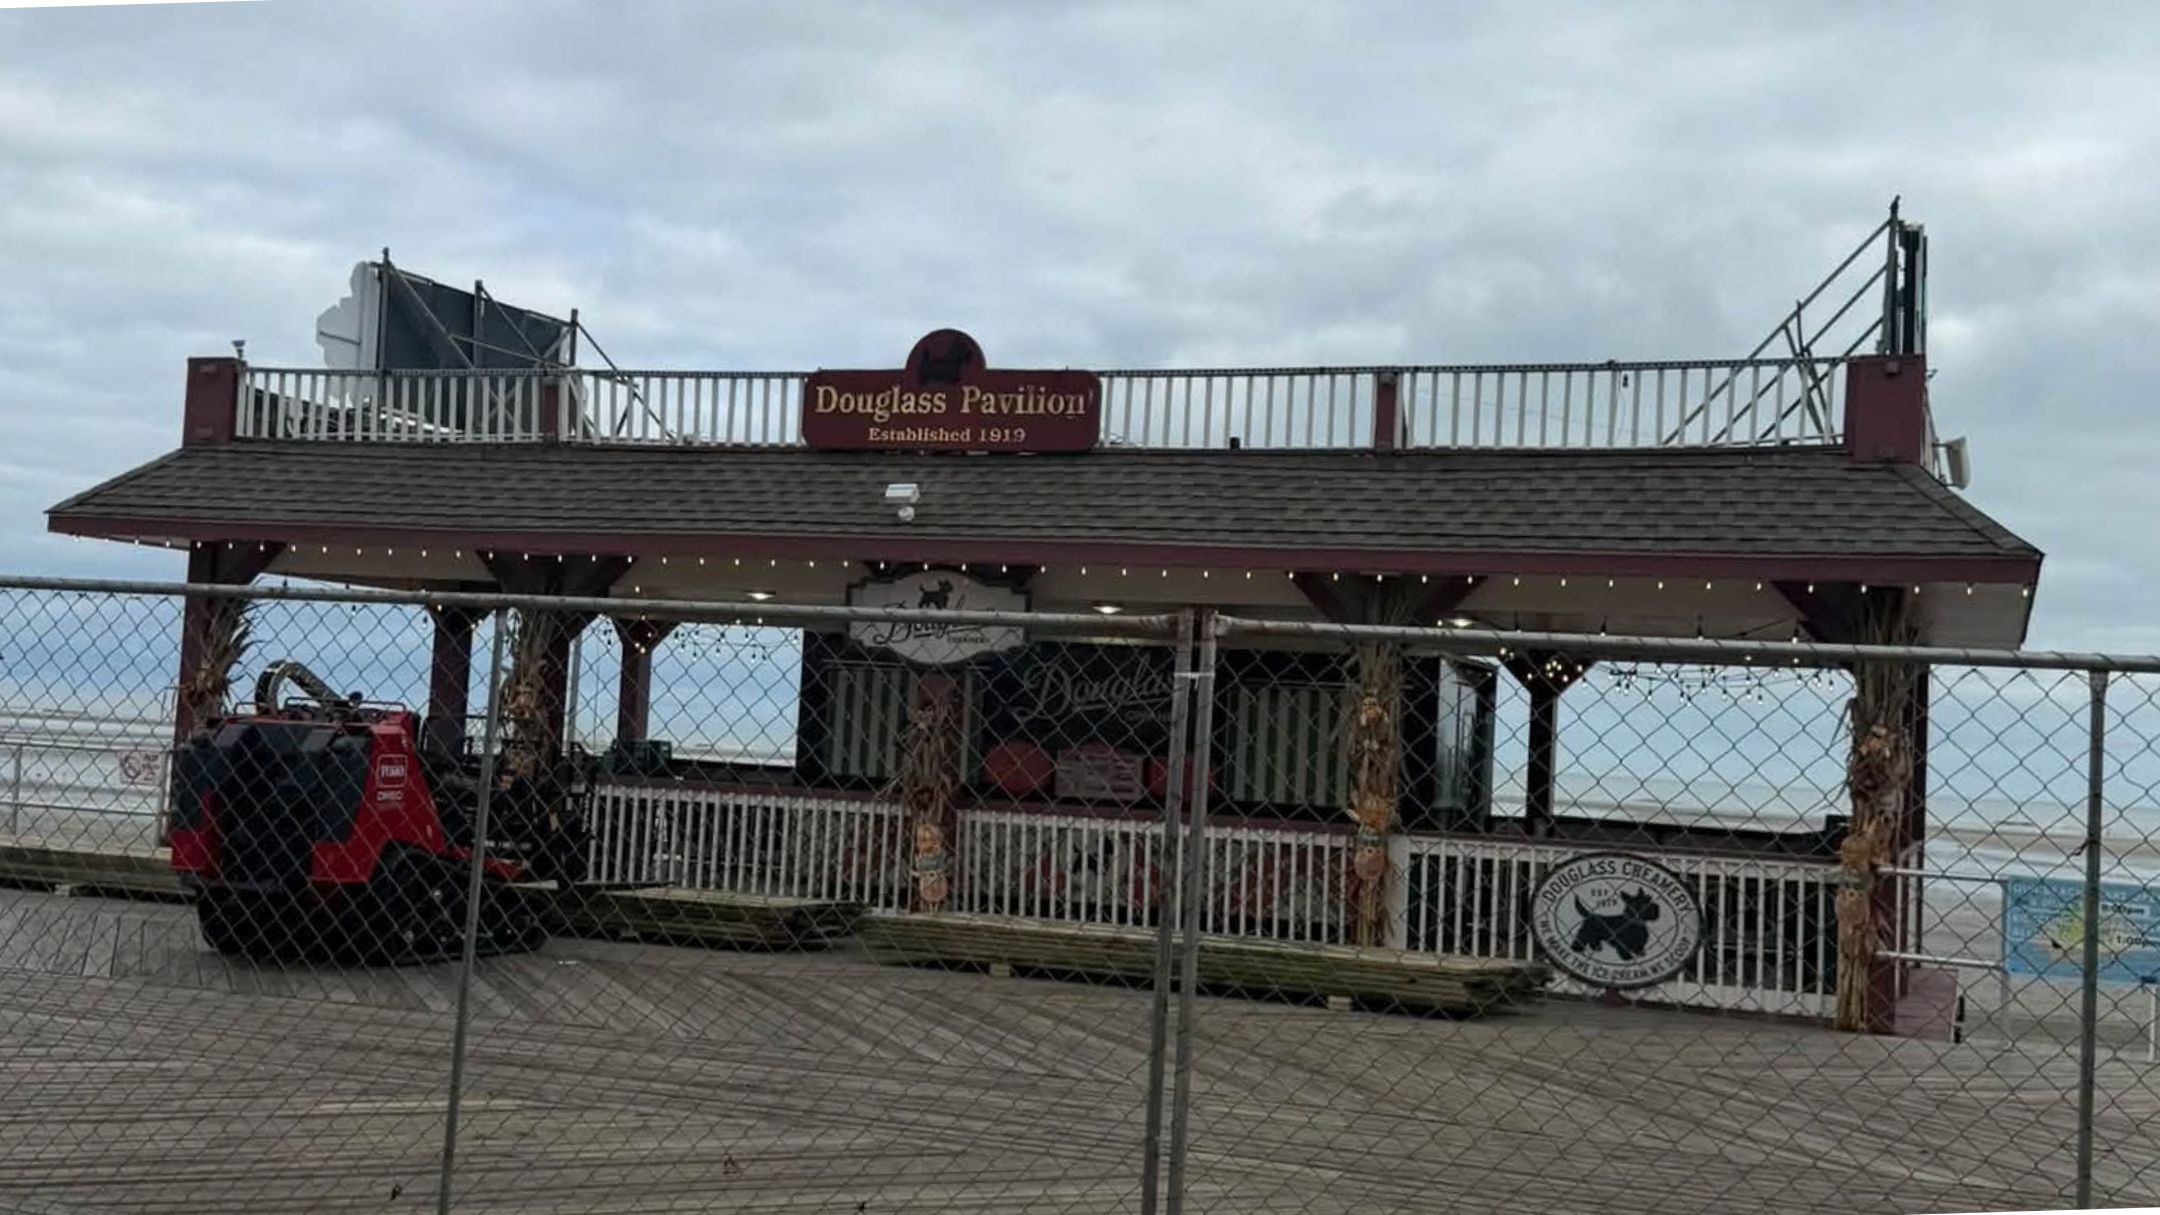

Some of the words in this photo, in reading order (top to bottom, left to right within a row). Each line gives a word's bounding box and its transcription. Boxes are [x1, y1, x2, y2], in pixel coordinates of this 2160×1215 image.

[815, 385, 947, 423] Douglass
[960, 385, 1087, 416] Pavilion
[868, 427, 971, 442] Established
[1542, 861, 1617, 905] DOUGLASS
[1622, 860, 1696, 912] CREAMERY
